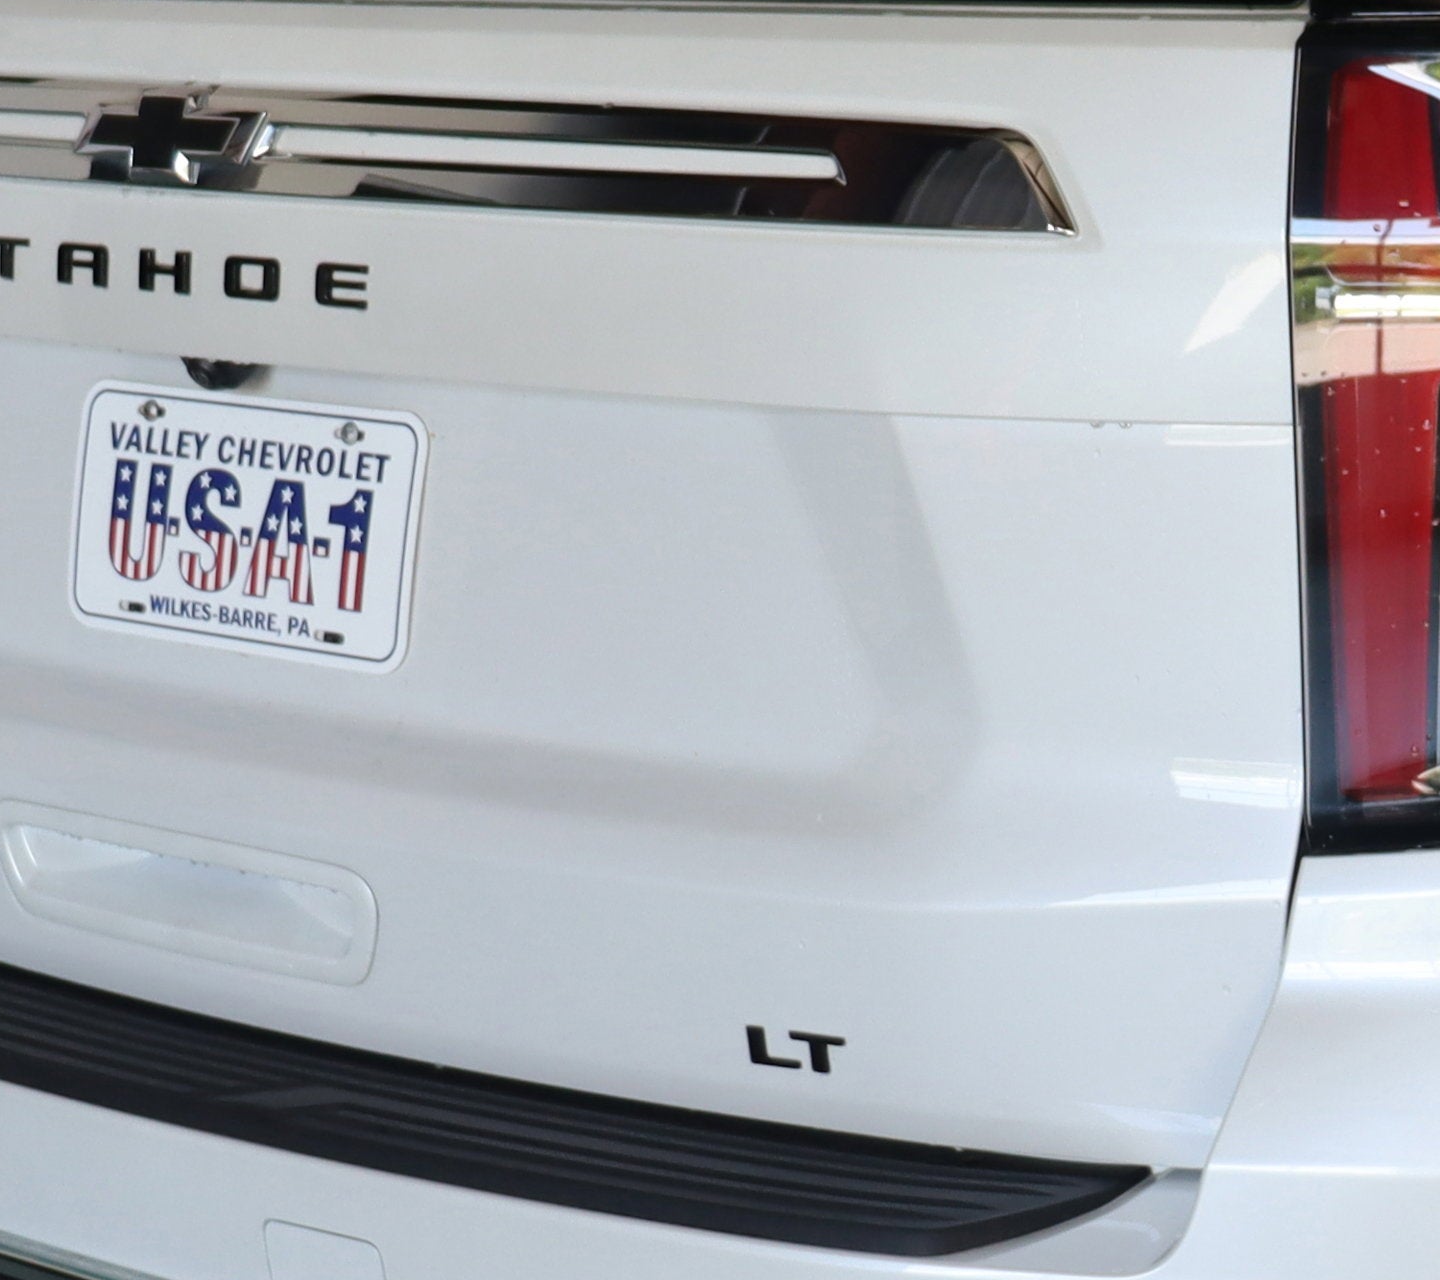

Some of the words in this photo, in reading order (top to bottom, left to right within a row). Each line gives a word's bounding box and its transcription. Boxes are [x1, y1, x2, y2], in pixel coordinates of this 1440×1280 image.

[110, 421, 210, 462] VALLEY
[218, 434, 392, 485] CHEVROLET
[287, 617, 311, 639] PA
[745, 1023, 847, 1075] LT
